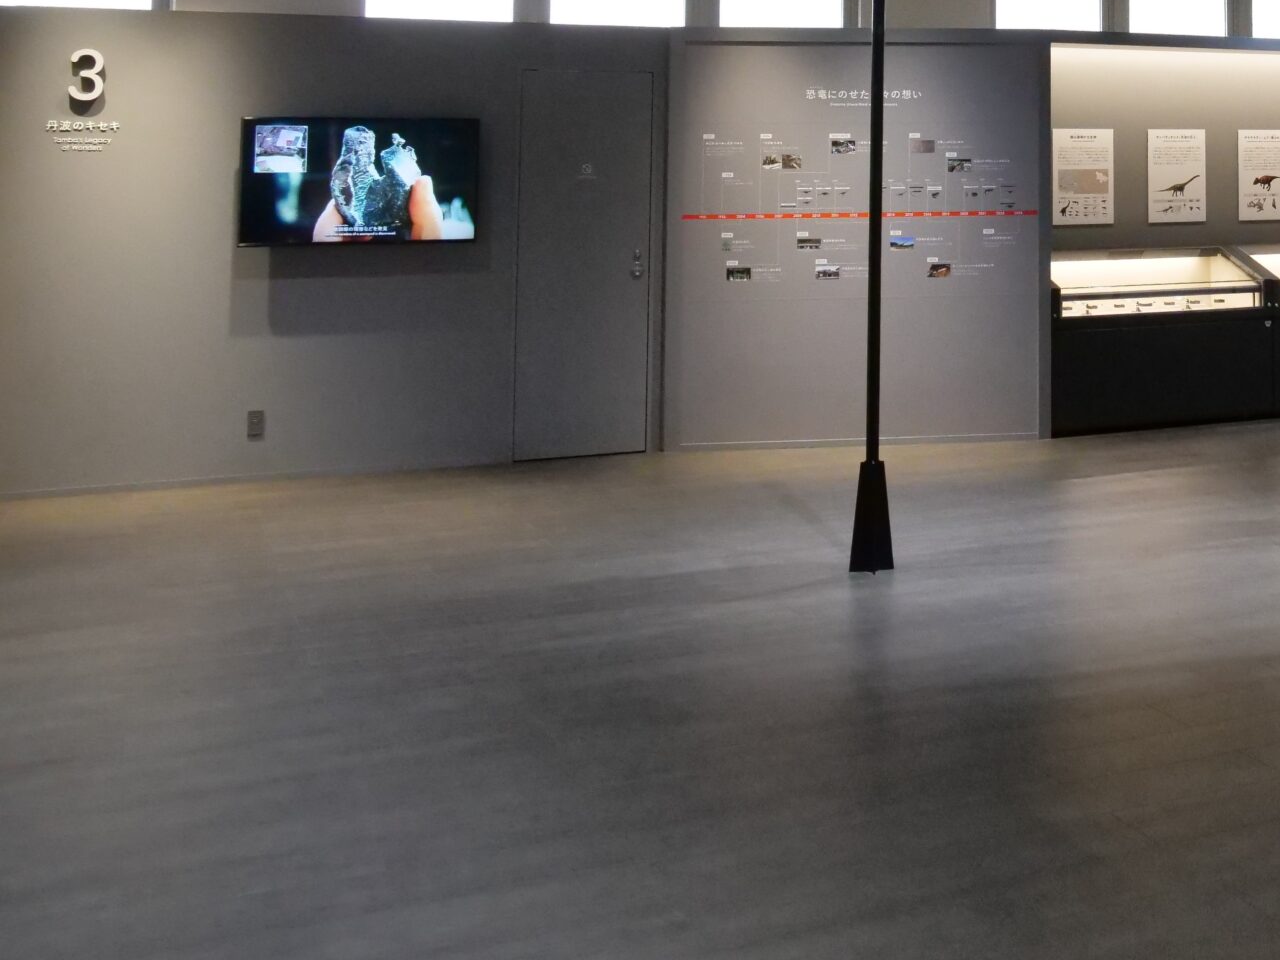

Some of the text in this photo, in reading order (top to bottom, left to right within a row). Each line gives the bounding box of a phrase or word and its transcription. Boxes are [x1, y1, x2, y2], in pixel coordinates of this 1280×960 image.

[68, 48, 105, 101] 3
[806, 89, 922, 100] 恐竜にのせた々の想い
[45, 120, 120, 132] 丹波のキセキ
